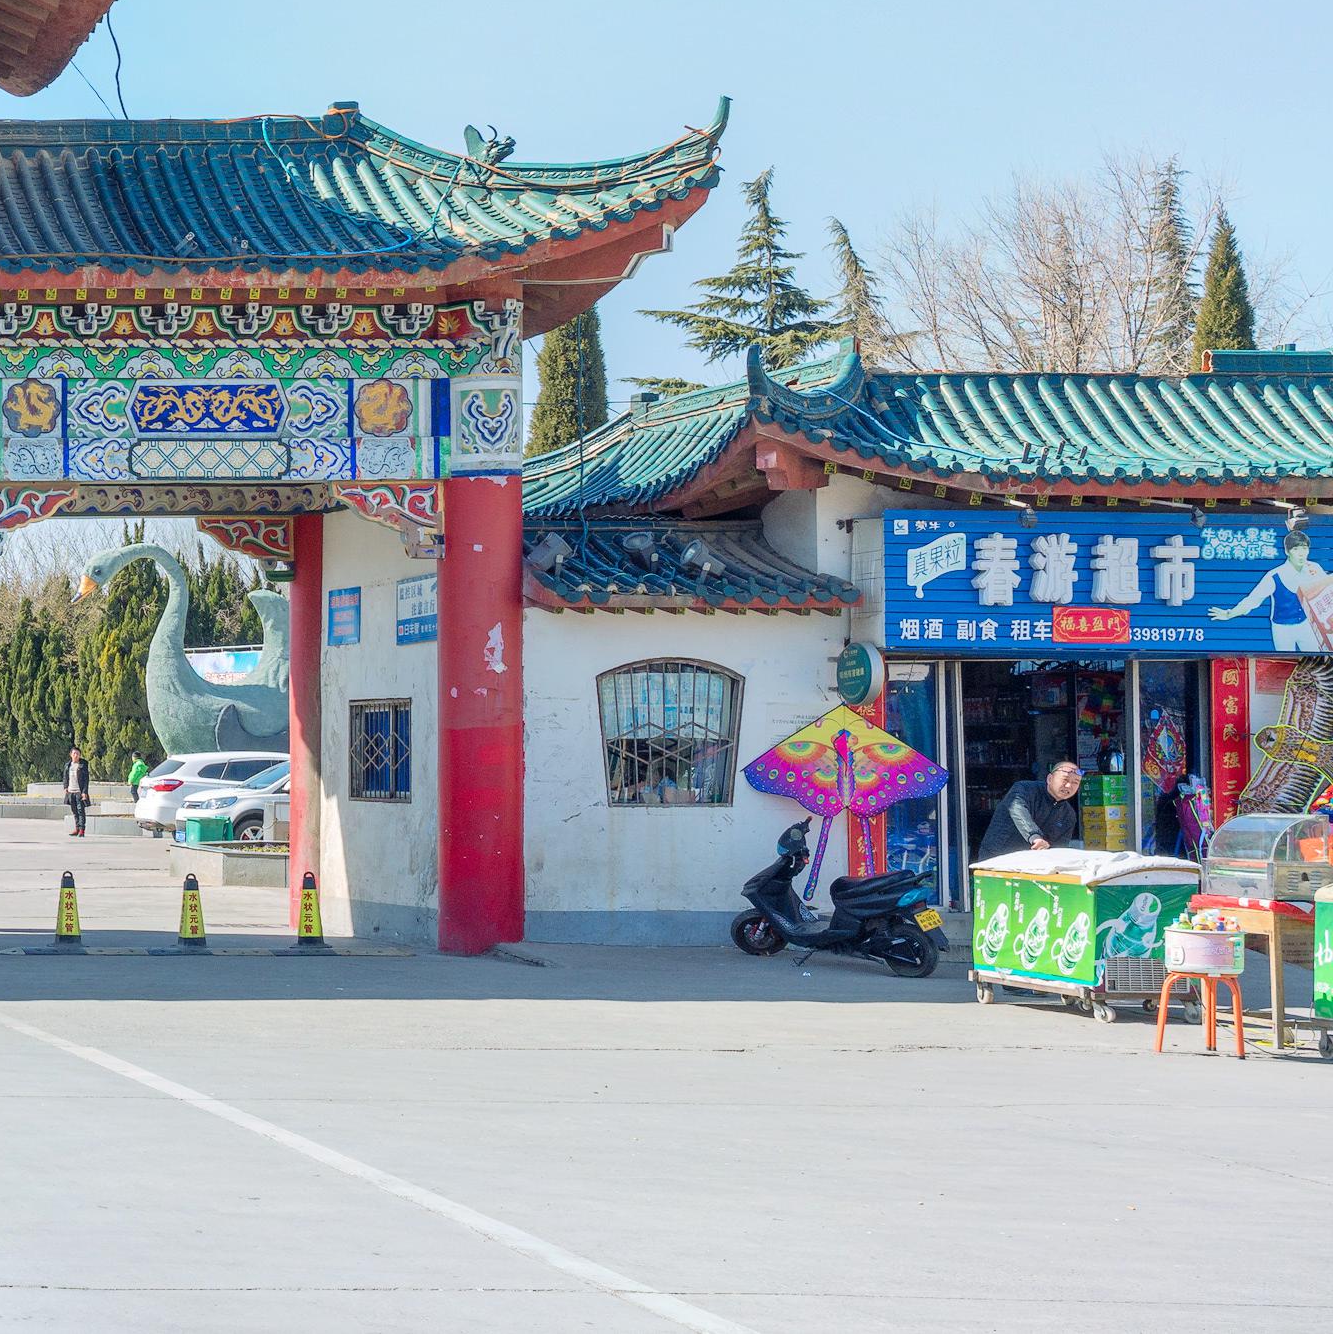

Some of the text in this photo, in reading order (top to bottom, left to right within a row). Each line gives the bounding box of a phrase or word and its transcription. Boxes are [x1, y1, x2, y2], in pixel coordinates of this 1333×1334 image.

[1200, 527, 1278, 544] 牛奶+果粒
[1201, 545, 1279, 561] 自然有乐趣
[913, 539, 961, 579] 真果粒
[971, 532, 1200, 606] 春游超市
[899, 619, 944, 641] 烟酒
[956, 618, 999, 642] 副食
[1010, 619, 1053, 642] 租车
[64, 890, 74, 933] 水状元管
[188, 892, 199, 935] 水状元管
[303, 890, 314, 934] 水状元管
